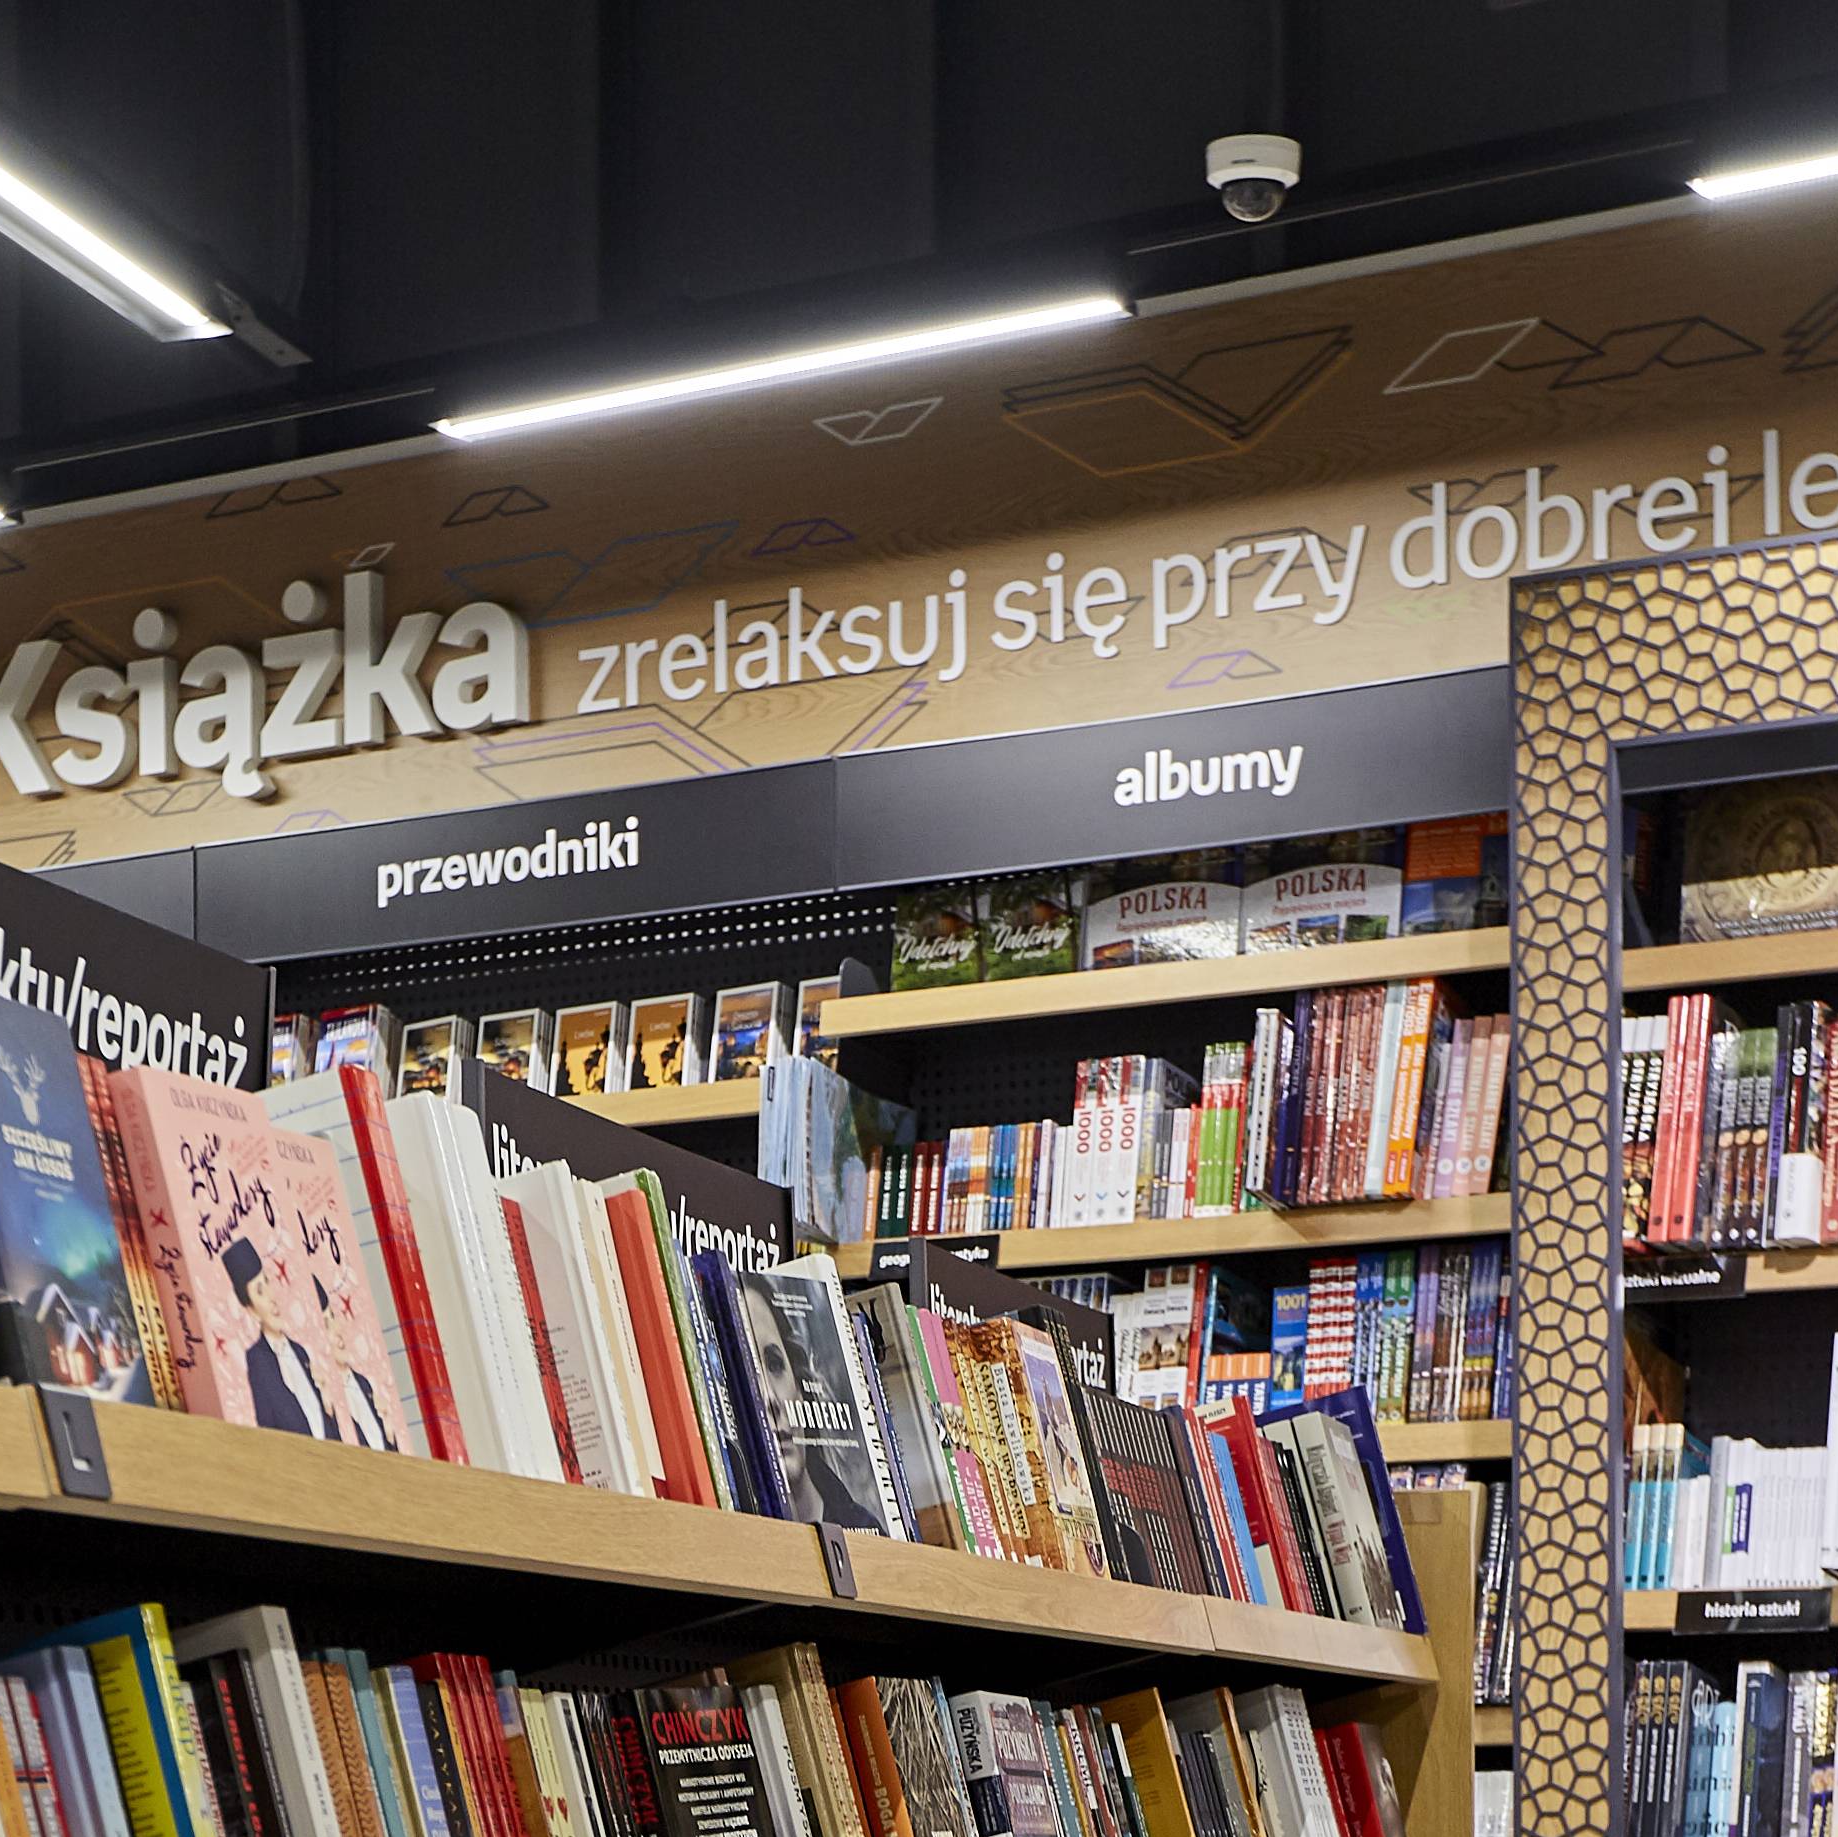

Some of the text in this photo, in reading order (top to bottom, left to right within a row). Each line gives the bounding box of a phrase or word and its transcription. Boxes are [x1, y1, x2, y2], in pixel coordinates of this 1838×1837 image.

[576, 566, 969, 714] zrelaksuj
[991, 550, 1128, 659] się
[1151, 524, 1368, 650] przy
[1113, 745, 1304, 807] albumy
[376, 815, 641, 908] przewodniki
[1119, 884, 1208, 919] POLSKA
[1275, 867, 1367, 901] POLSKA
[1077, 1110, 1092, 1154] 1000
[1099, 1108, 1114, 1153] 1000
[1119, 1106, 1136, 1151] 1000
[784, 1399, 853, 1431] MORDERCY
[1705, 1599, 1801, 1620] historia sztuki
[651, 1703, 751, 1745] CHIŃCZYK
[956, 1708, 983, 1775] PUZYŃSKA
[717, 1743, 754, 1762] ODYSEJA
[875, 1785, 896, 1832] BOGA
